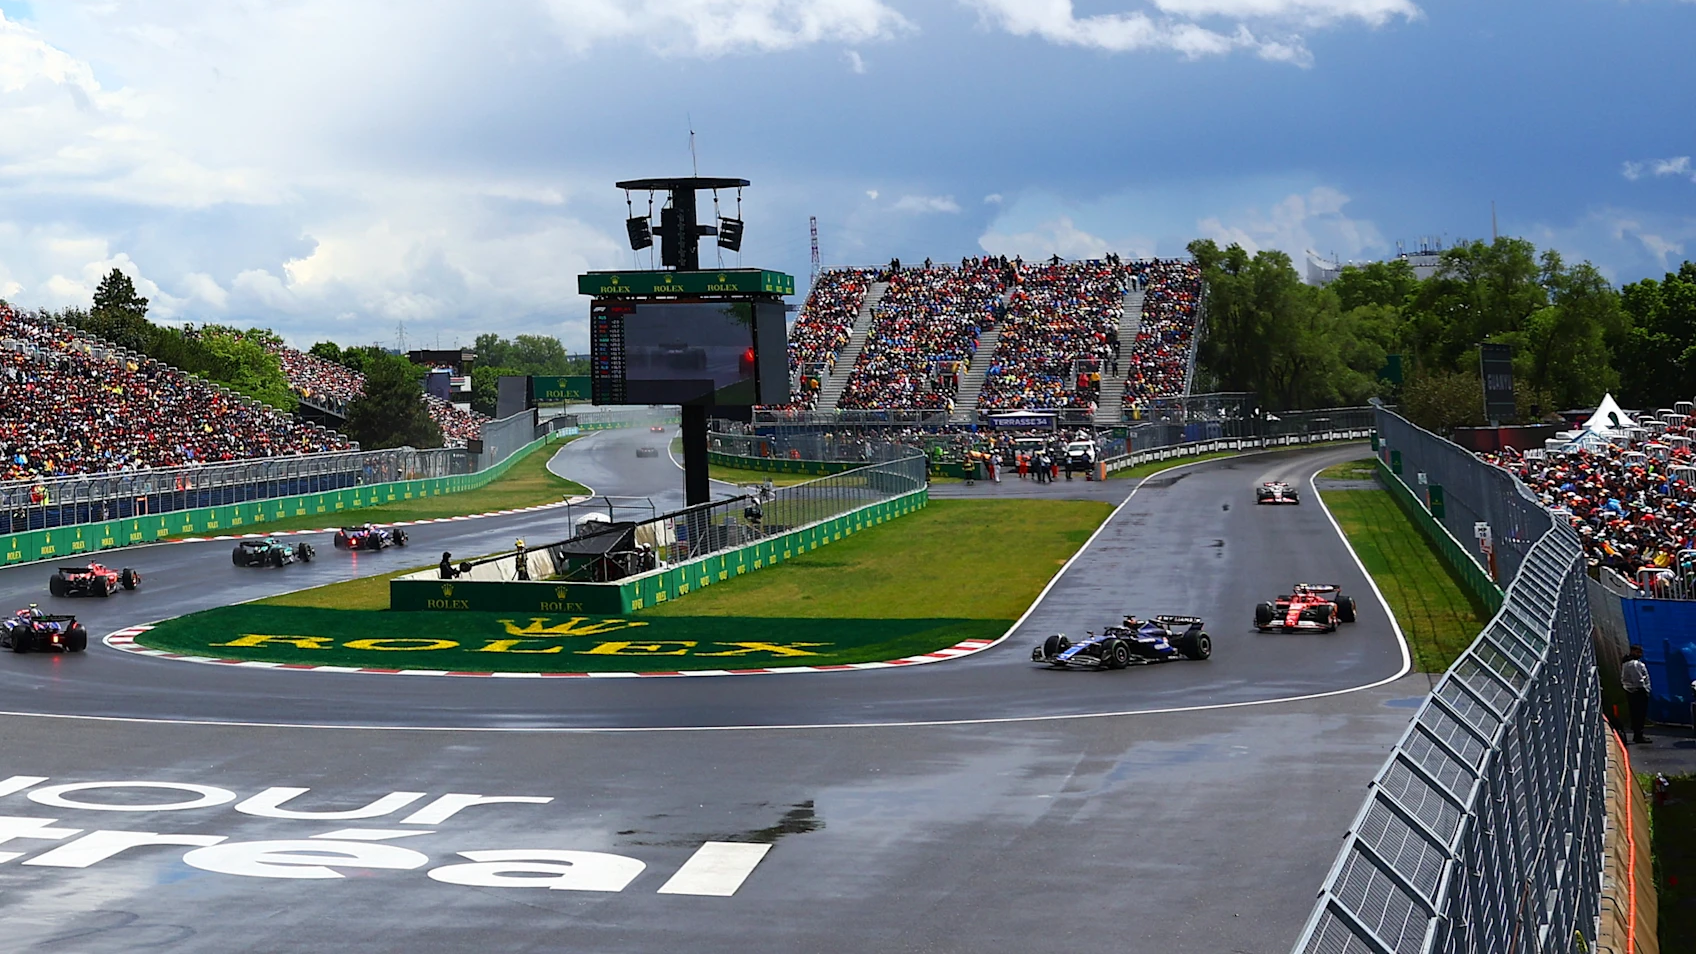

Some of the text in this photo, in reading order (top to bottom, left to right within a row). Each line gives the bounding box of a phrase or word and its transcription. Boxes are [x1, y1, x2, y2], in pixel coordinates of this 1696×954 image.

[601, 285, 631, 293] ROLEX
[654, 284, 684, 292] ROLEX
[707, 283, 738, 291] ROLEX
[546, 390, 580, 398] ROLEX
[427, 599, 469, 610] ROLEX
[540, 602, 583, 612] ROLEX
[208, 633, 837, 657] ROLEX
